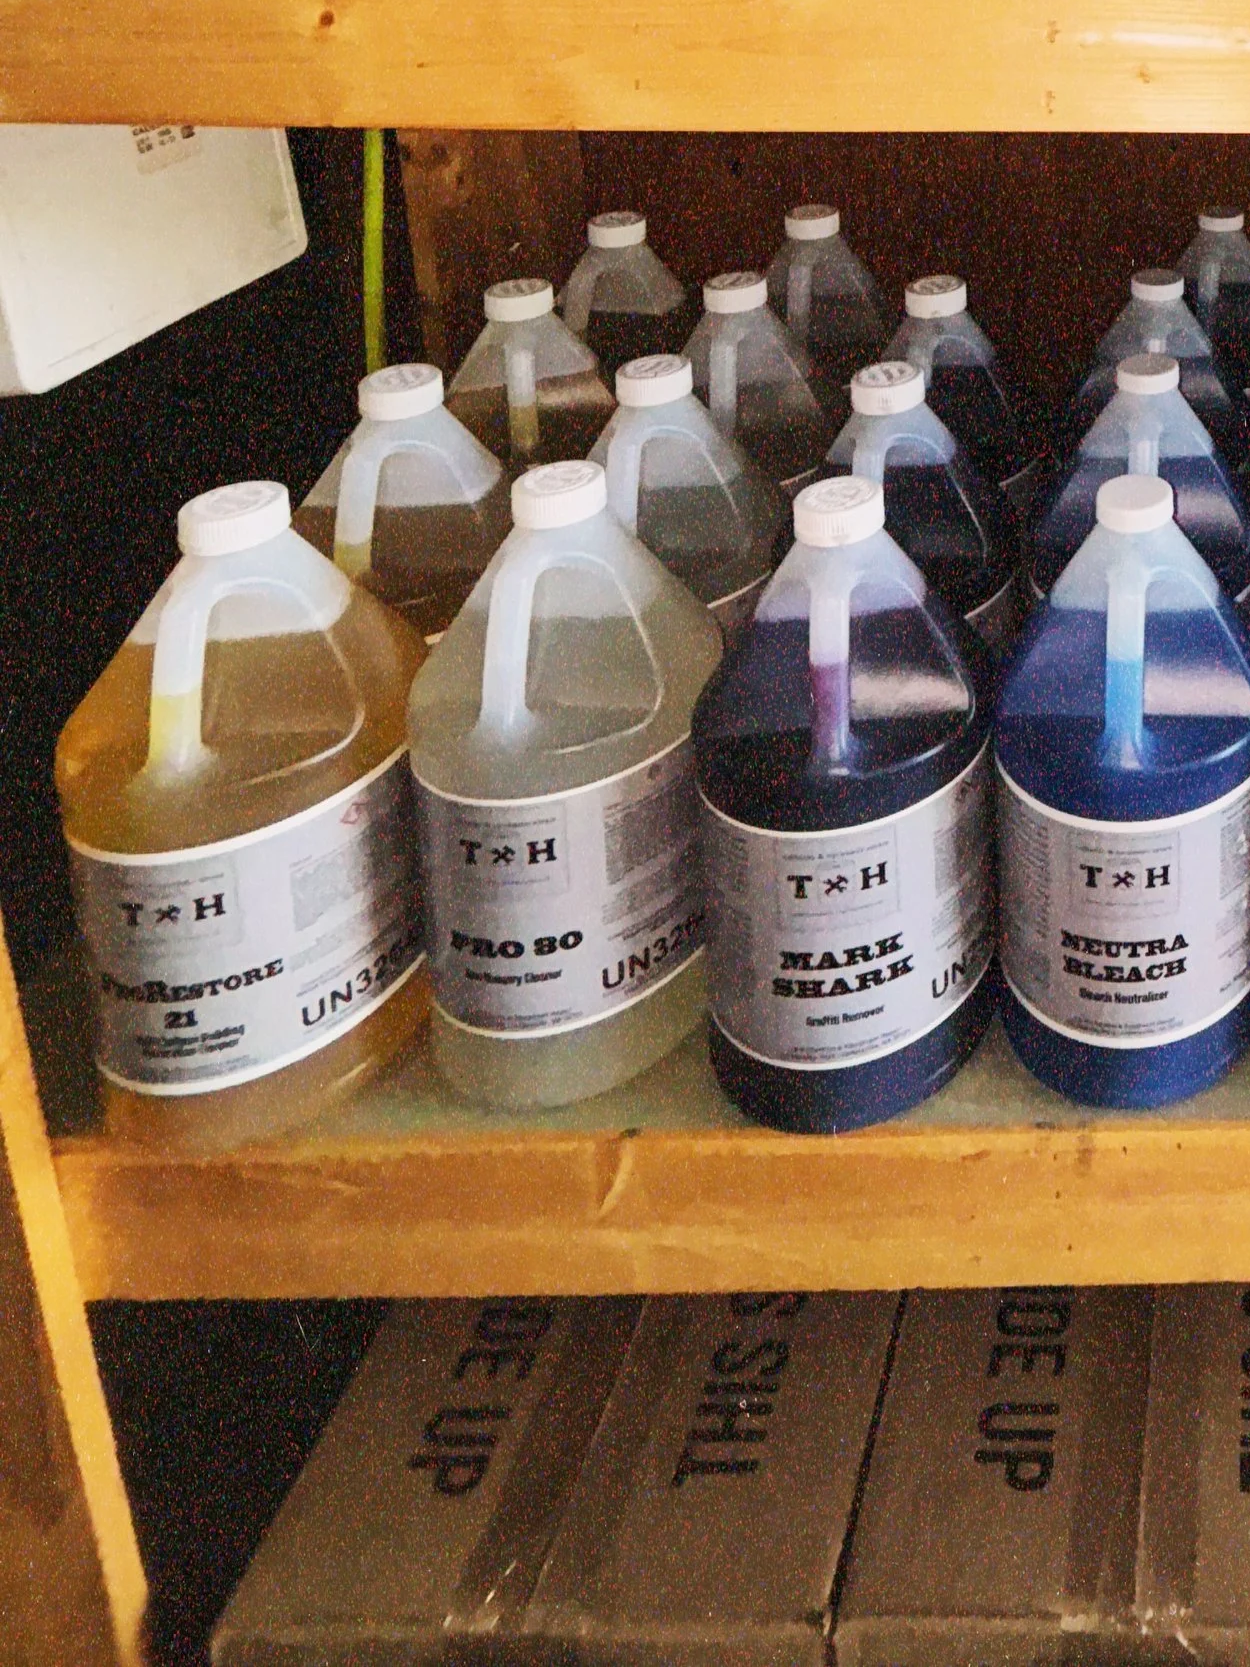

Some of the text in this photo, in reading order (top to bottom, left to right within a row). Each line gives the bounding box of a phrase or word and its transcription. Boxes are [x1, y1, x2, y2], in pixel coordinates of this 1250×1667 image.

[459, 837, 557, 865] T H
[787, 861, 888, 899] T H
[1080, 863, 1171, 889] T H
[118, 892, 225, 926] T H
[779, 932, 904, 971] MARK
[1061, 928, 1189, 958] NEUTRA
[771, 954, 914, 999] SHARK
[1063, 954, 1187, 983] BLEACH
[1114, 990, 1169, 1005] Neutralizer
[670, 1338, 792, 1489] THIS
[405, 1405, 513, 1498] UP
[973, 1401, 1061, 1493] UP
